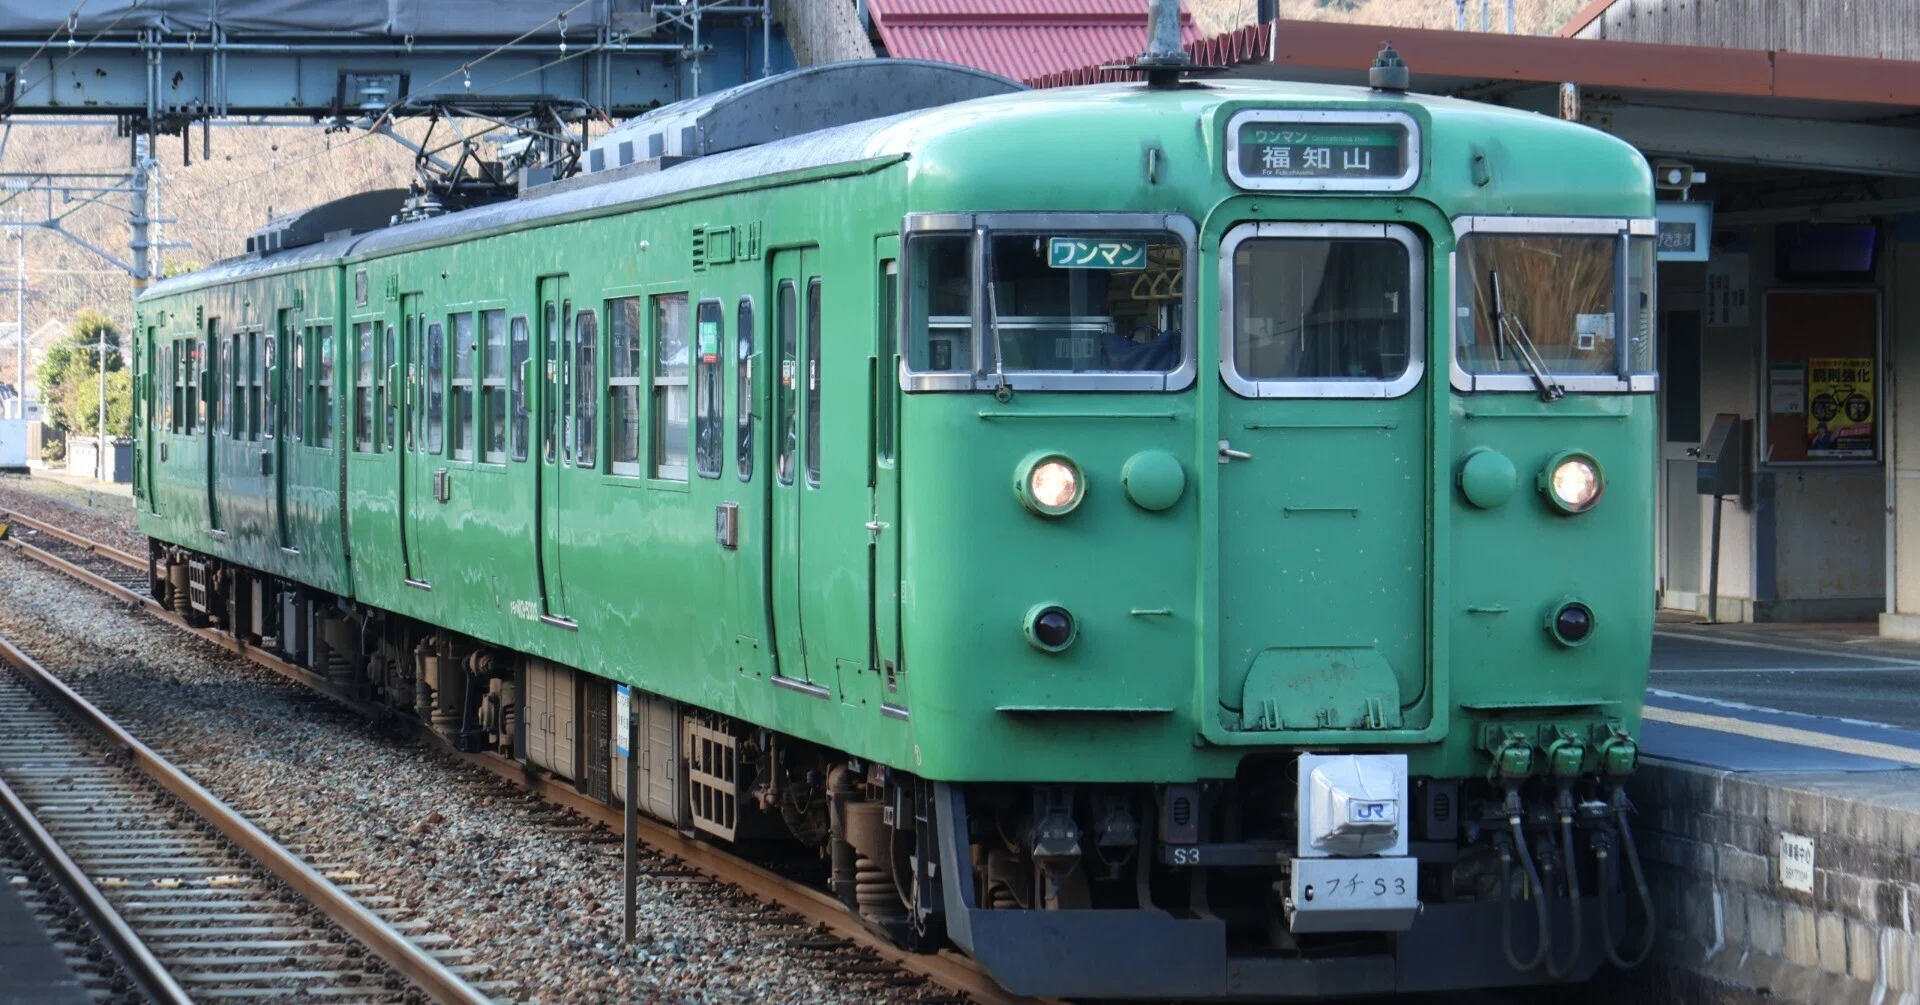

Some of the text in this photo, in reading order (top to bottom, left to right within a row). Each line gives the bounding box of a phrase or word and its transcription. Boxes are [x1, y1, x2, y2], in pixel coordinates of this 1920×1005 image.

[1255, 130, 1308, 143] ワンマン
[1262, 146, 1370, 170] 福知山
[1054, 242, 1143, 266] ワンマン
[1357, 803, 1385, 819] JR
[1174, 848, 1199, 865] S3
